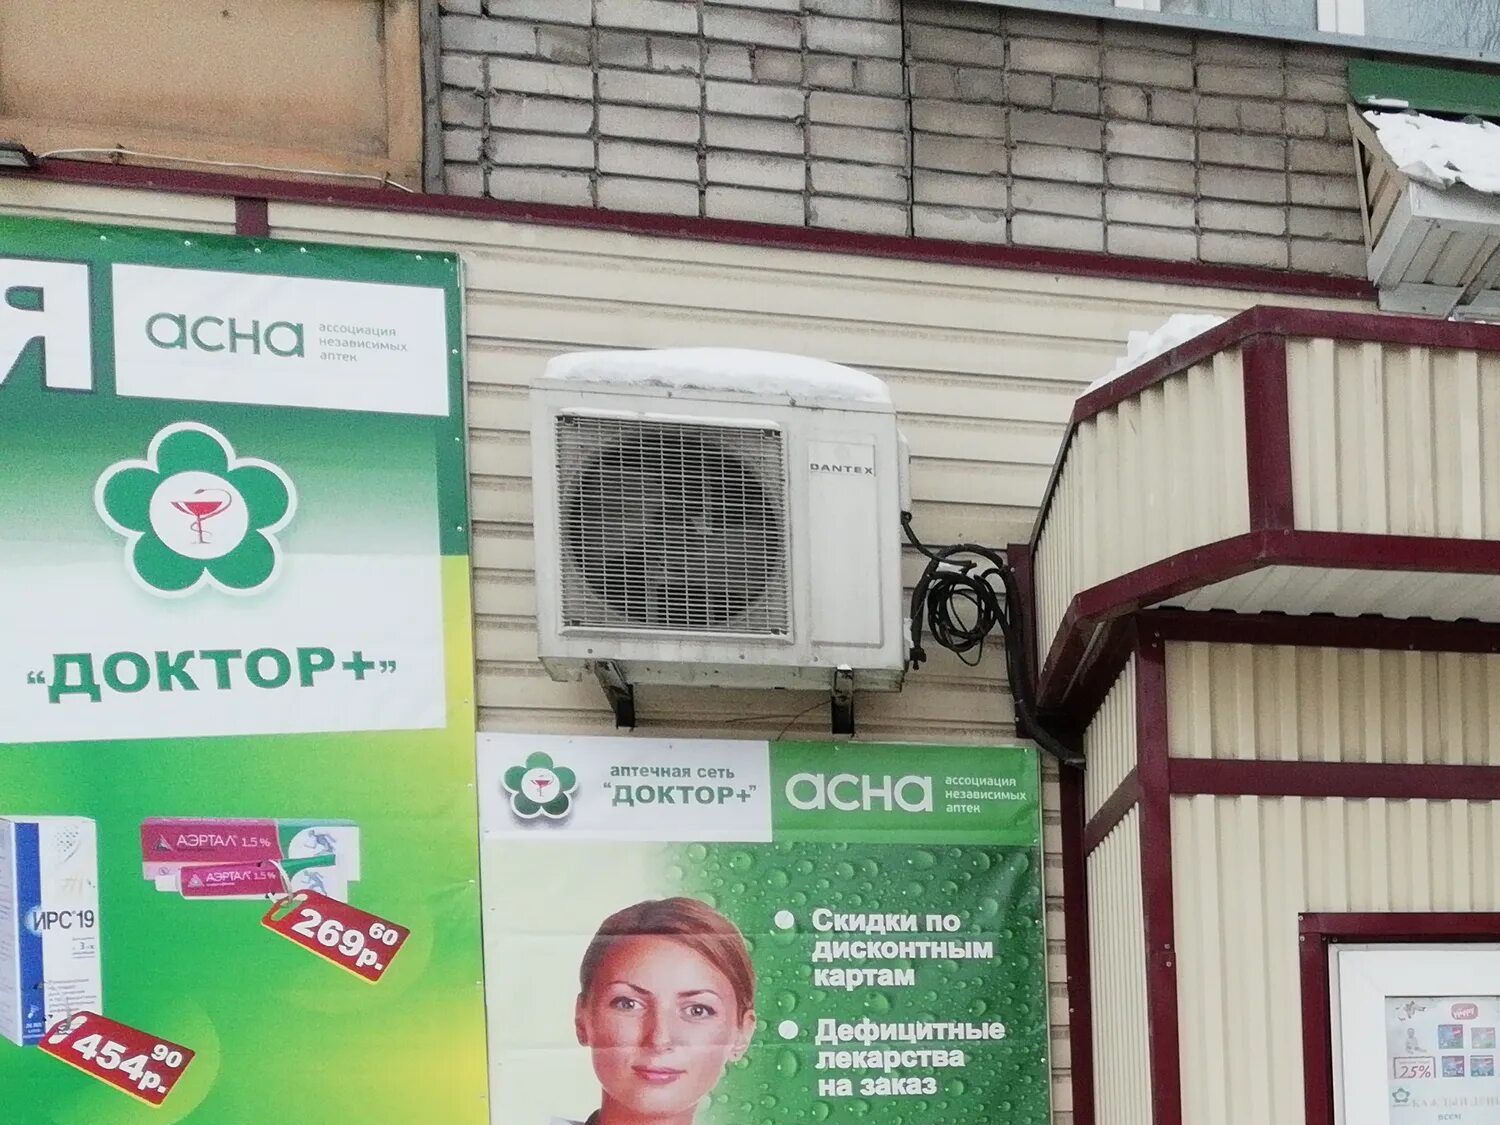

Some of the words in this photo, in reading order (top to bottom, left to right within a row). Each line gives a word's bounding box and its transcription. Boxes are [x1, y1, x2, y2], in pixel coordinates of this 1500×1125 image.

[144, 311, 306, 358] асна
[319, 323, 397, 337] ассоциация
[319, 338, 408, 352] независимых
[320, 352, 358, 362] аптек
[809, 463, 873, 475] DANTEX
[610, 765, 691, 778] аптечная
[697, 767, 735, 779] сеть
[945, 775, 1017, 787] ассоциация
[785, 773, 933, 812] асна
[945, 790, 1027, 801] независимых
[946, 803, 981, 813] аптек
[176, 834, 236, 847] АЭРТАЛ
[77, 909, 94, 928] 19
[812, 908, 917, 935] Скидки
[926, 913, 961, 932] по
[369, 922, 398, 946] 60
[812, 941, 993, 962] дисконтным
[814, 968, 915, 991] картам
[815, 1018, 1006, 1046] Дефицитные
[151, 1044, 182, 1068] 90
[815, 1049, 965, 1073] лекарства
[818, 1079, 853, 1097] на
[860, 1077, 938, 1096] заказ
